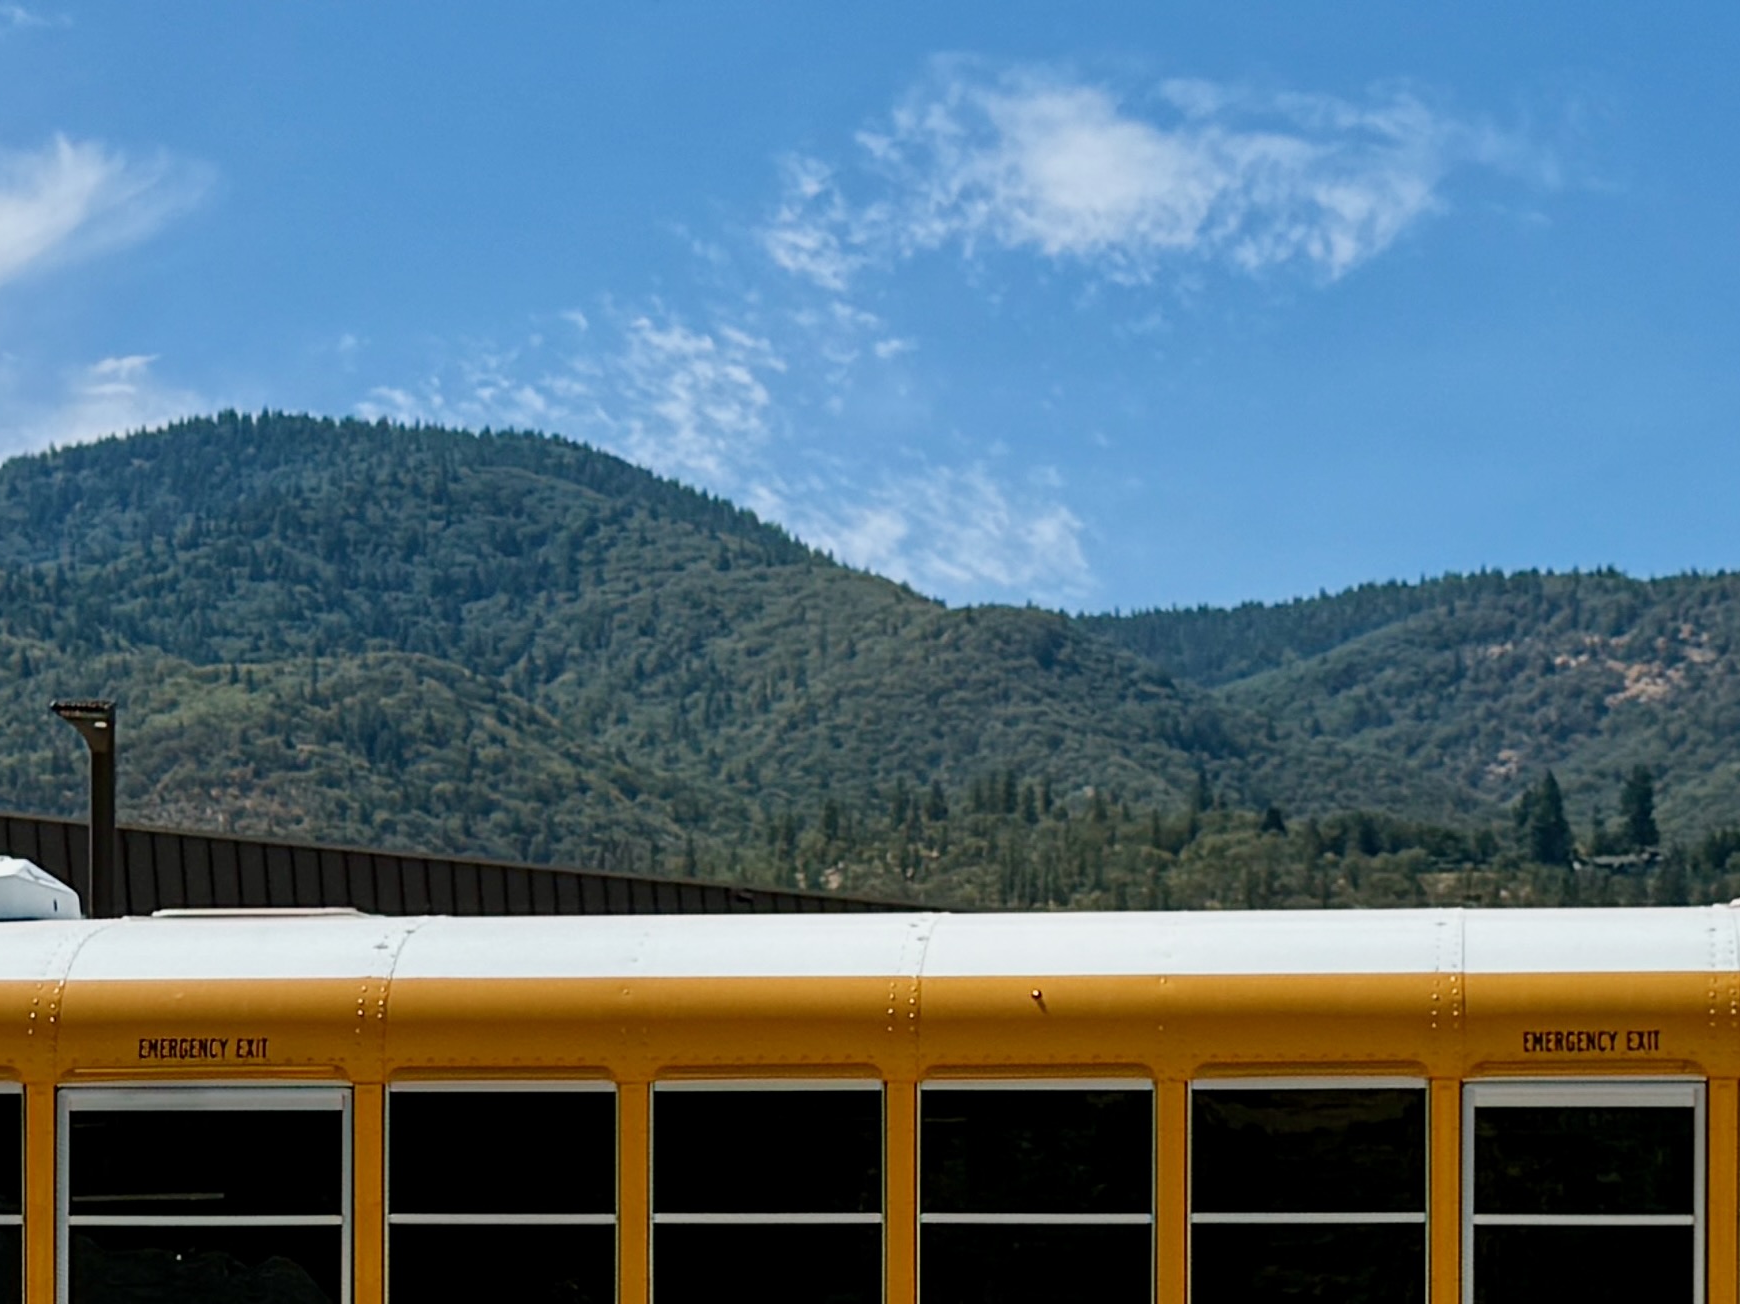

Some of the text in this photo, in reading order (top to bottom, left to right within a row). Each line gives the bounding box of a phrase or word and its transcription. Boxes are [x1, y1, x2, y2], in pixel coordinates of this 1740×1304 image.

[138, 1037, 268, 1059] EMERGENCY EXIT
[1523, 1030, 1660, 1053] EMERGENCY EXIT
